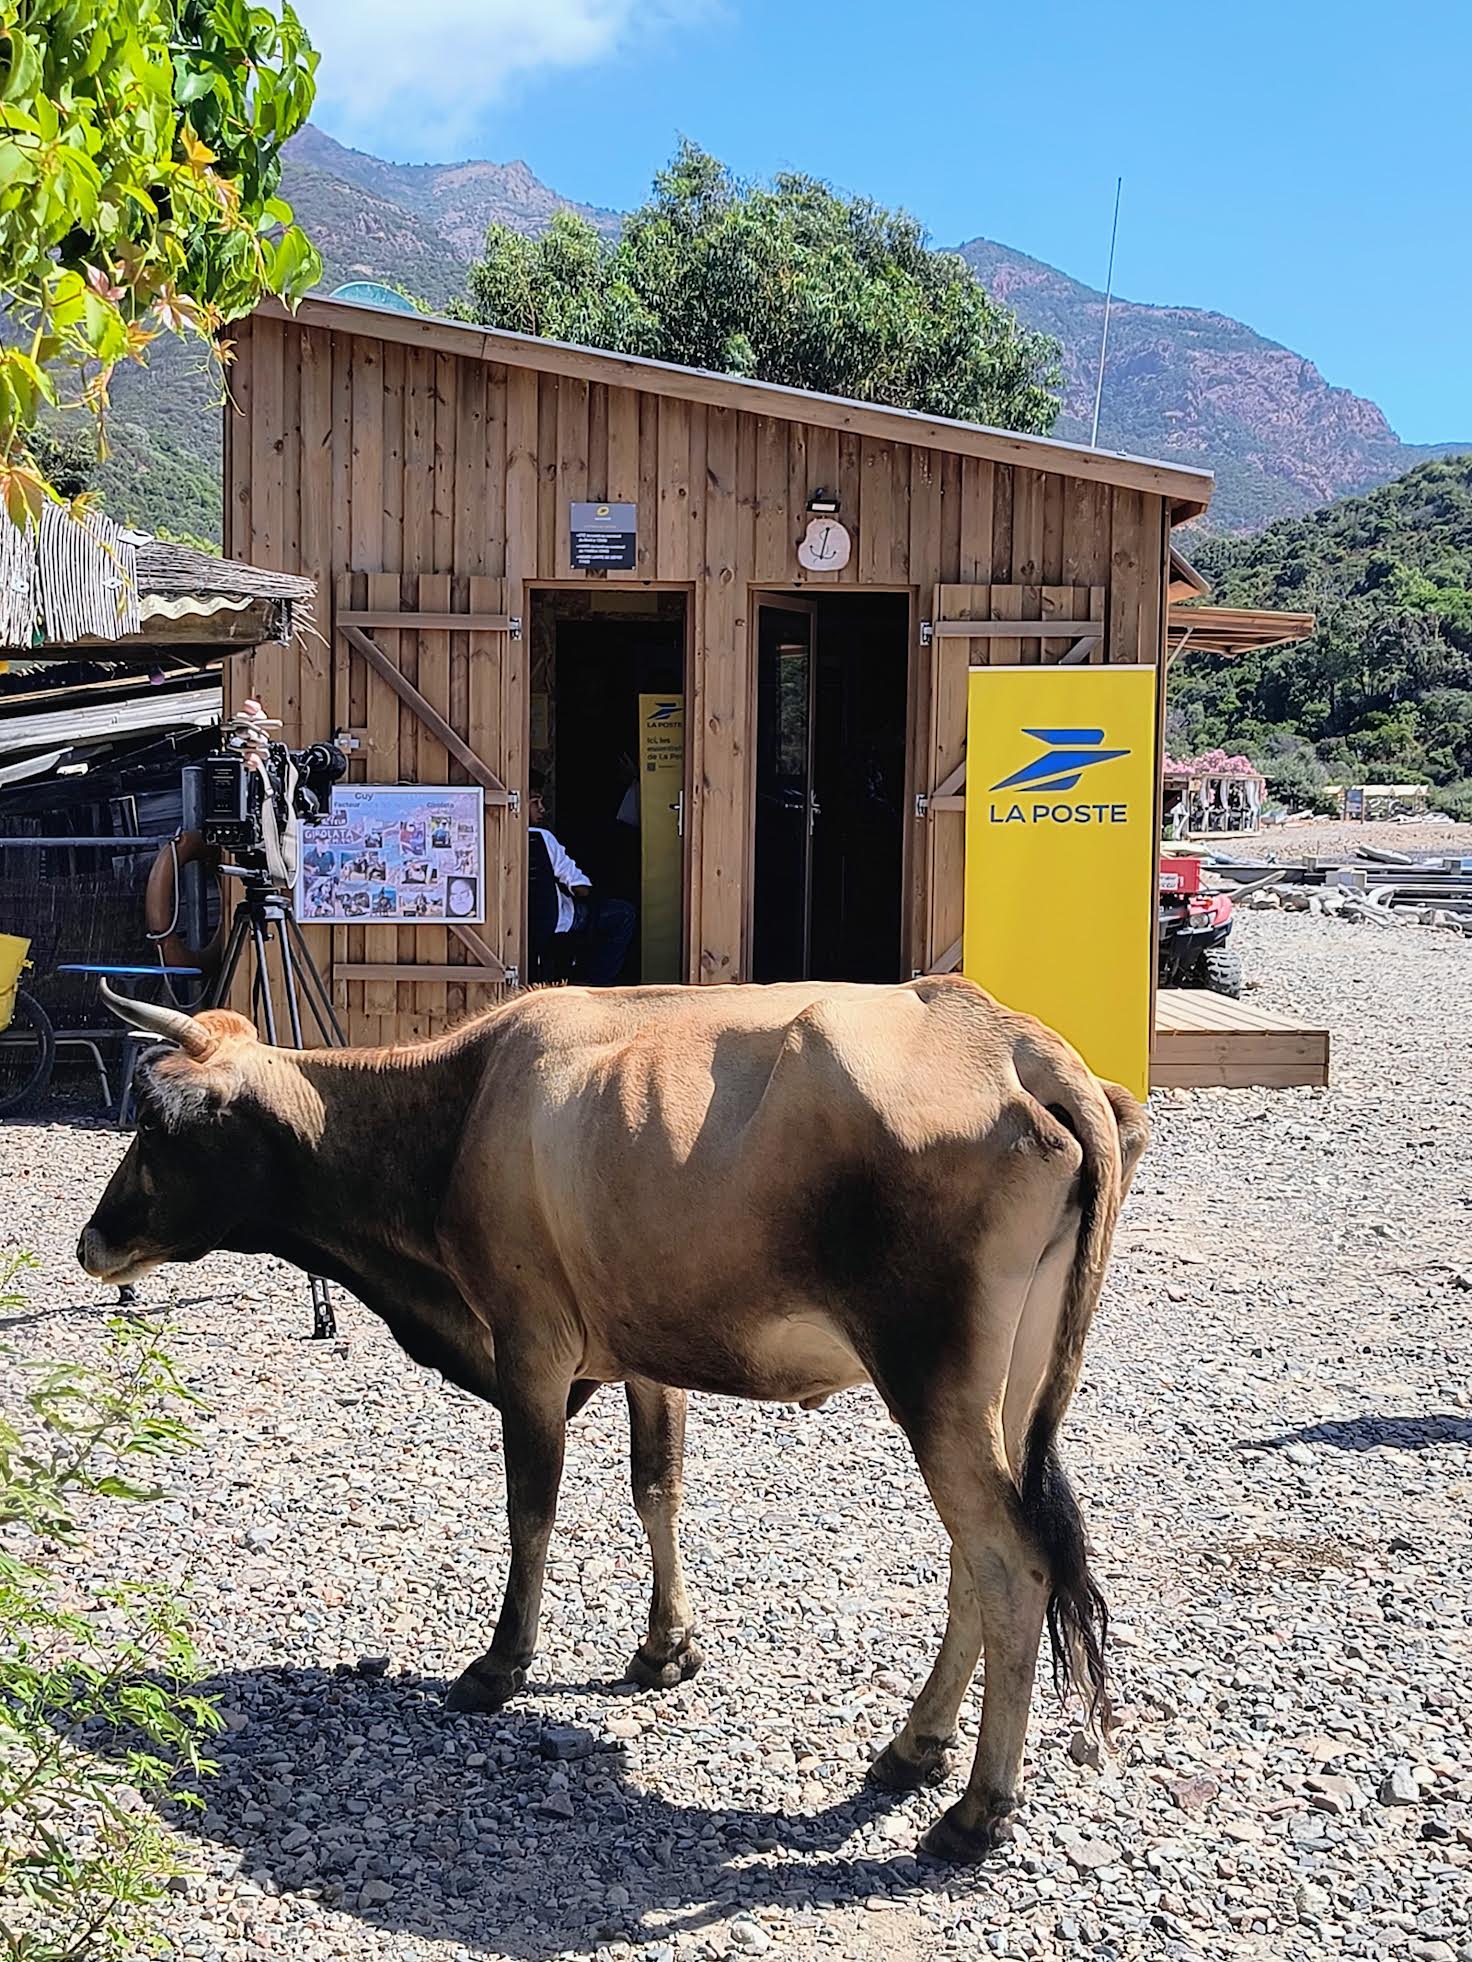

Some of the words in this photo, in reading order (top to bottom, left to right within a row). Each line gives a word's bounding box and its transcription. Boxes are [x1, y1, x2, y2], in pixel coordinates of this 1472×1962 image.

[355, 792, 374, 802] Guy
[990, 804, 1026, 823] LA
[1033, 804, 1127, 823] POSTE
